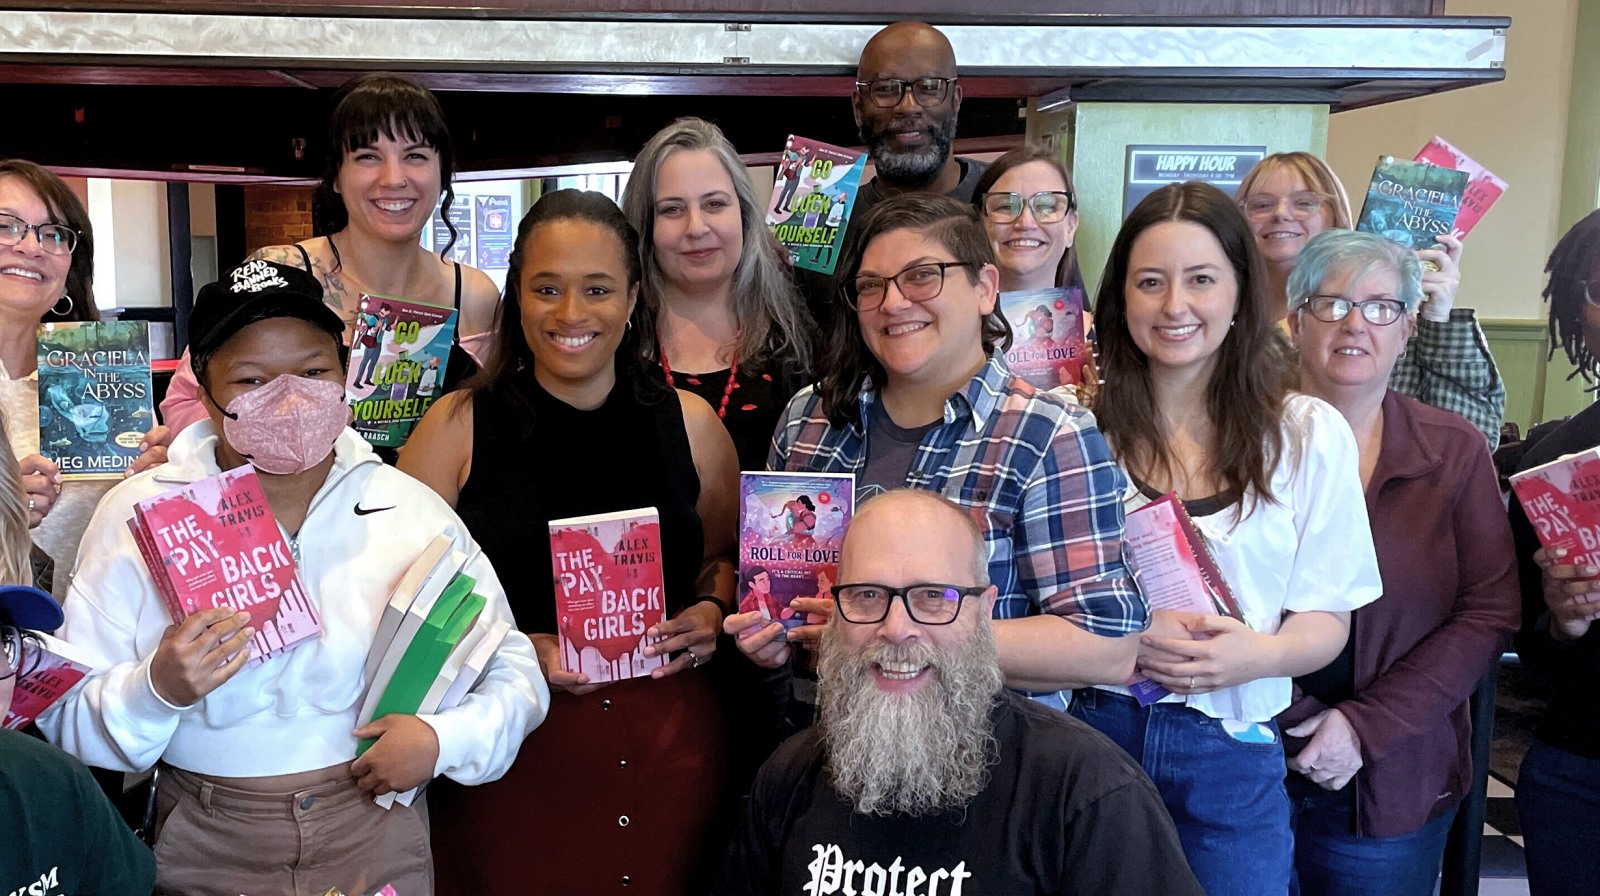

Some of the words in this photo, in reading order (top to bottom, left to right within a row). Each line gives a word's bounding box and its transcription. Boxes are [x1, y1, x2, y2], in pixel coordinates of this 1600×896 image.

[811, 160, 833, 179] GO
[1156, 155, 1199, 171] HAPPY
[1198, 155, 1237, 171] HOUR
[791, 194, 832, 214] LUCK
[1378, 180, 1459, 208] GRACIELA
[1404, 200, 1415, 210] IN
[1414, 206, 1433, 218] THE
[1395, 212, 1450, 235] ABYSS
[230, 260, 267, 283] READ
[230, 267, 278, 293] BANNED
[248, 276, 289, 292] BOOKS
[394, 321, 420, 345] GO
[46, 350, 147, 370] GRACIELA
[1046, 347, 1076, 360] LOVE
[84, 368, 97, 378] IN
[97, 372, 120, 383] THE
[374, 359, 422, 385] LUCK
[82, 382, 146, 402] ABYSS
[221, 491, 254, 511] ALEX
[1524, 492, 1559, 518] THE
[219, 505, 265, 527] TRAVIS
[158, 515, 203, 549] THE
[618, 538, 648, 552] ALEX
[751, 547, 785, 561] ROLL
[805, 550, 840, 563] LOVE
[220, 540, 290, 584] BACK
[556, 548, 596, 571] THE
[613, 552, 655, 566] TRAVIS
[211, 572, 281, 611] GIRLS
[601, 587, 660, 615] BACK
[584, 612, 646, 641] GIRLS
[803, 843, 972, 896] Protect
